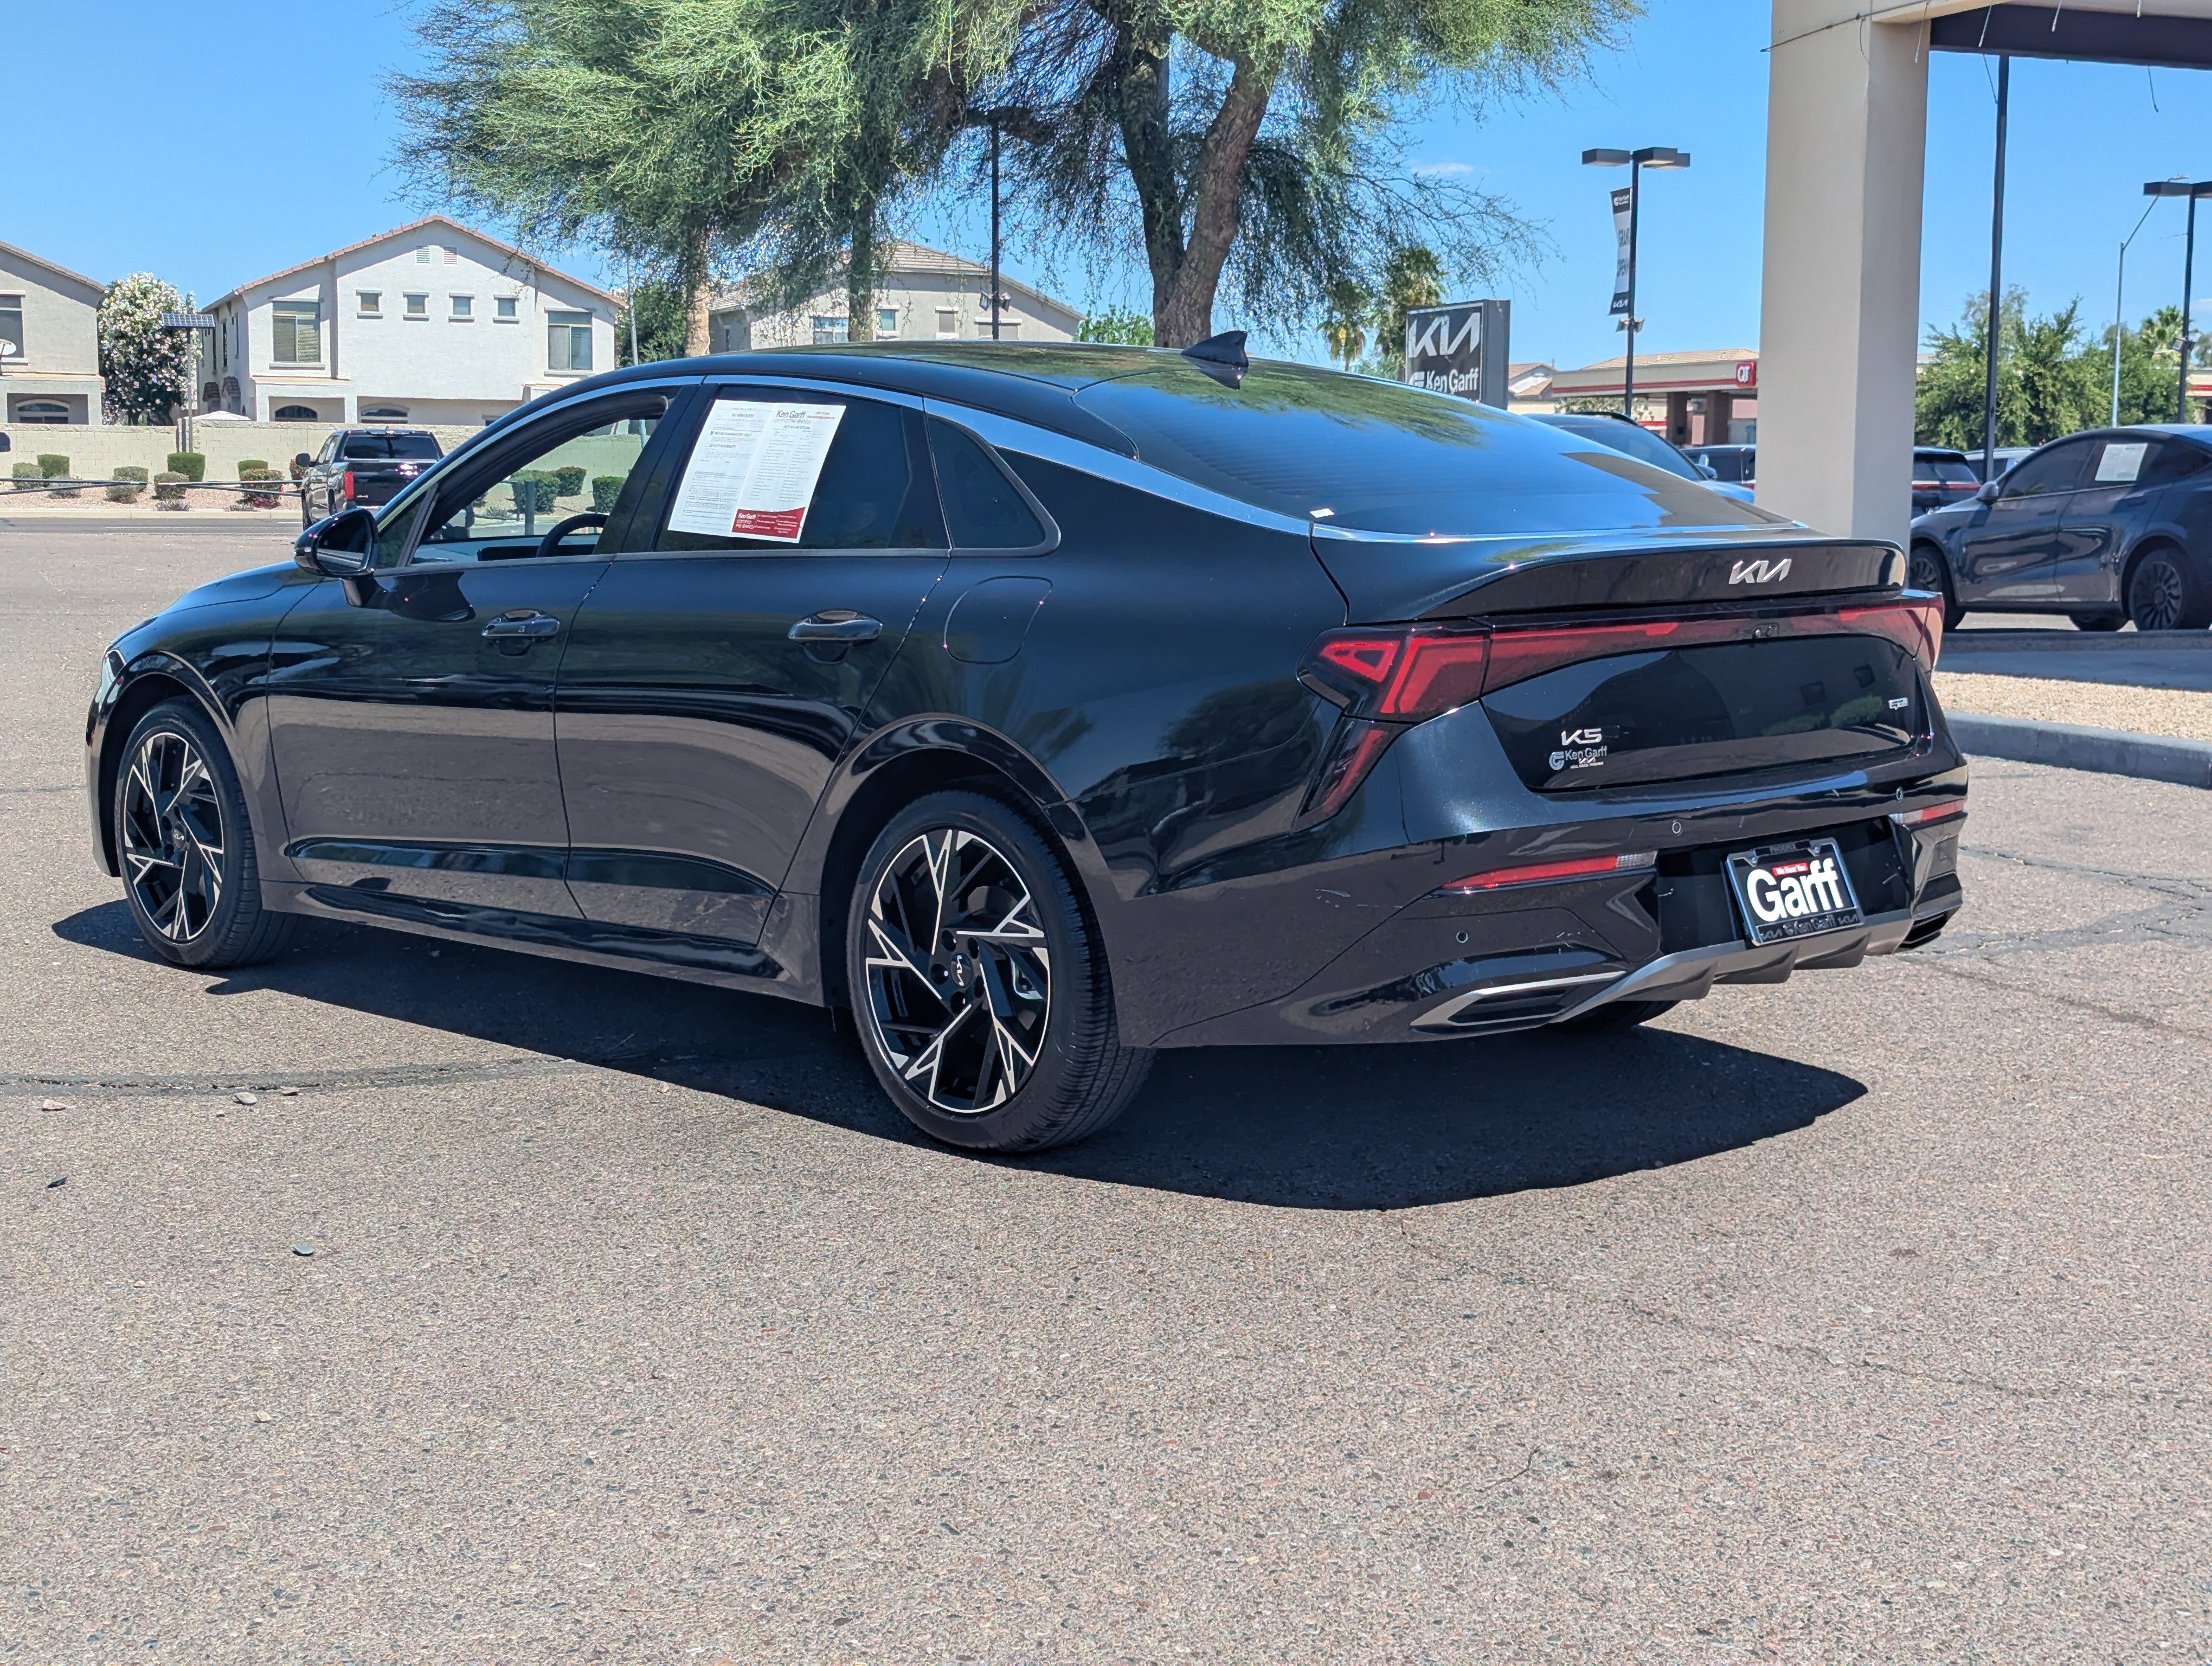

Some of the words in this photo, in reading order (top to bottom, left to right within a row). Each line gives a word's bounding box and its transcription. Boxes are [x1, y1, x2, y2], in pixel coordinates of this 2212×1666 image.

[1408, 312, 1481, 358] KIA
[1426, 370, 1447, 393] Ken
[1449, 367, 1479, 392] Garff
[1737, 366, 1751, 383] QT
[776, 409, 789, 418] Ken
[789, 410, 807, 419] Garff
[1728, 558, 1792, 585] KIA
[1561, 727, 1602, 746] K5
[1565, 749, 1584, 760] Ken
[1585, 745, 1607, 758] Garff
[1747, 858, 1844, 922] Garff
